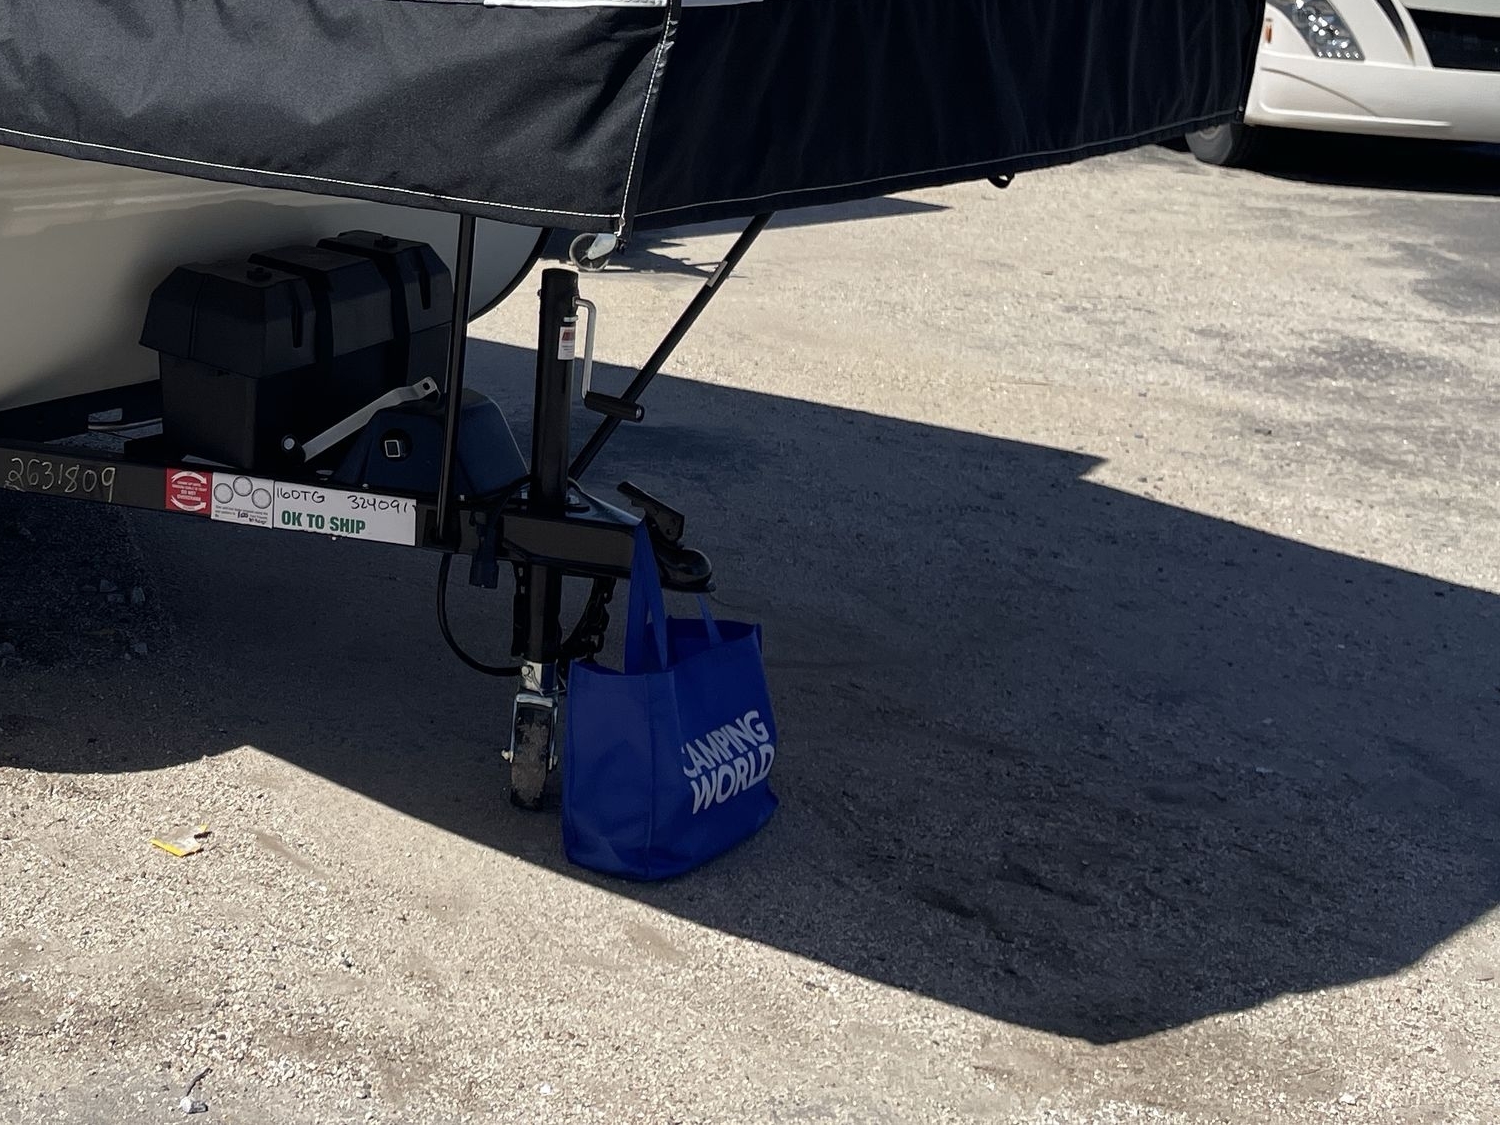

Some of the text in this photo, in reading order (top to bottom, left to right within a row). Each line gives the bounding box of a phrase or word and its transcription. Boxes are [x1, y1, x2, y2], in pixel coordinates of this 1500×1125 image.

[7, 457, 116, 503] 2631809
[281, 510, 303, 527] OK
[306, 513, 325, 530] TO
[329, 516, 366, 534] SHIP
[690, 743, 775, 815] WORLD
